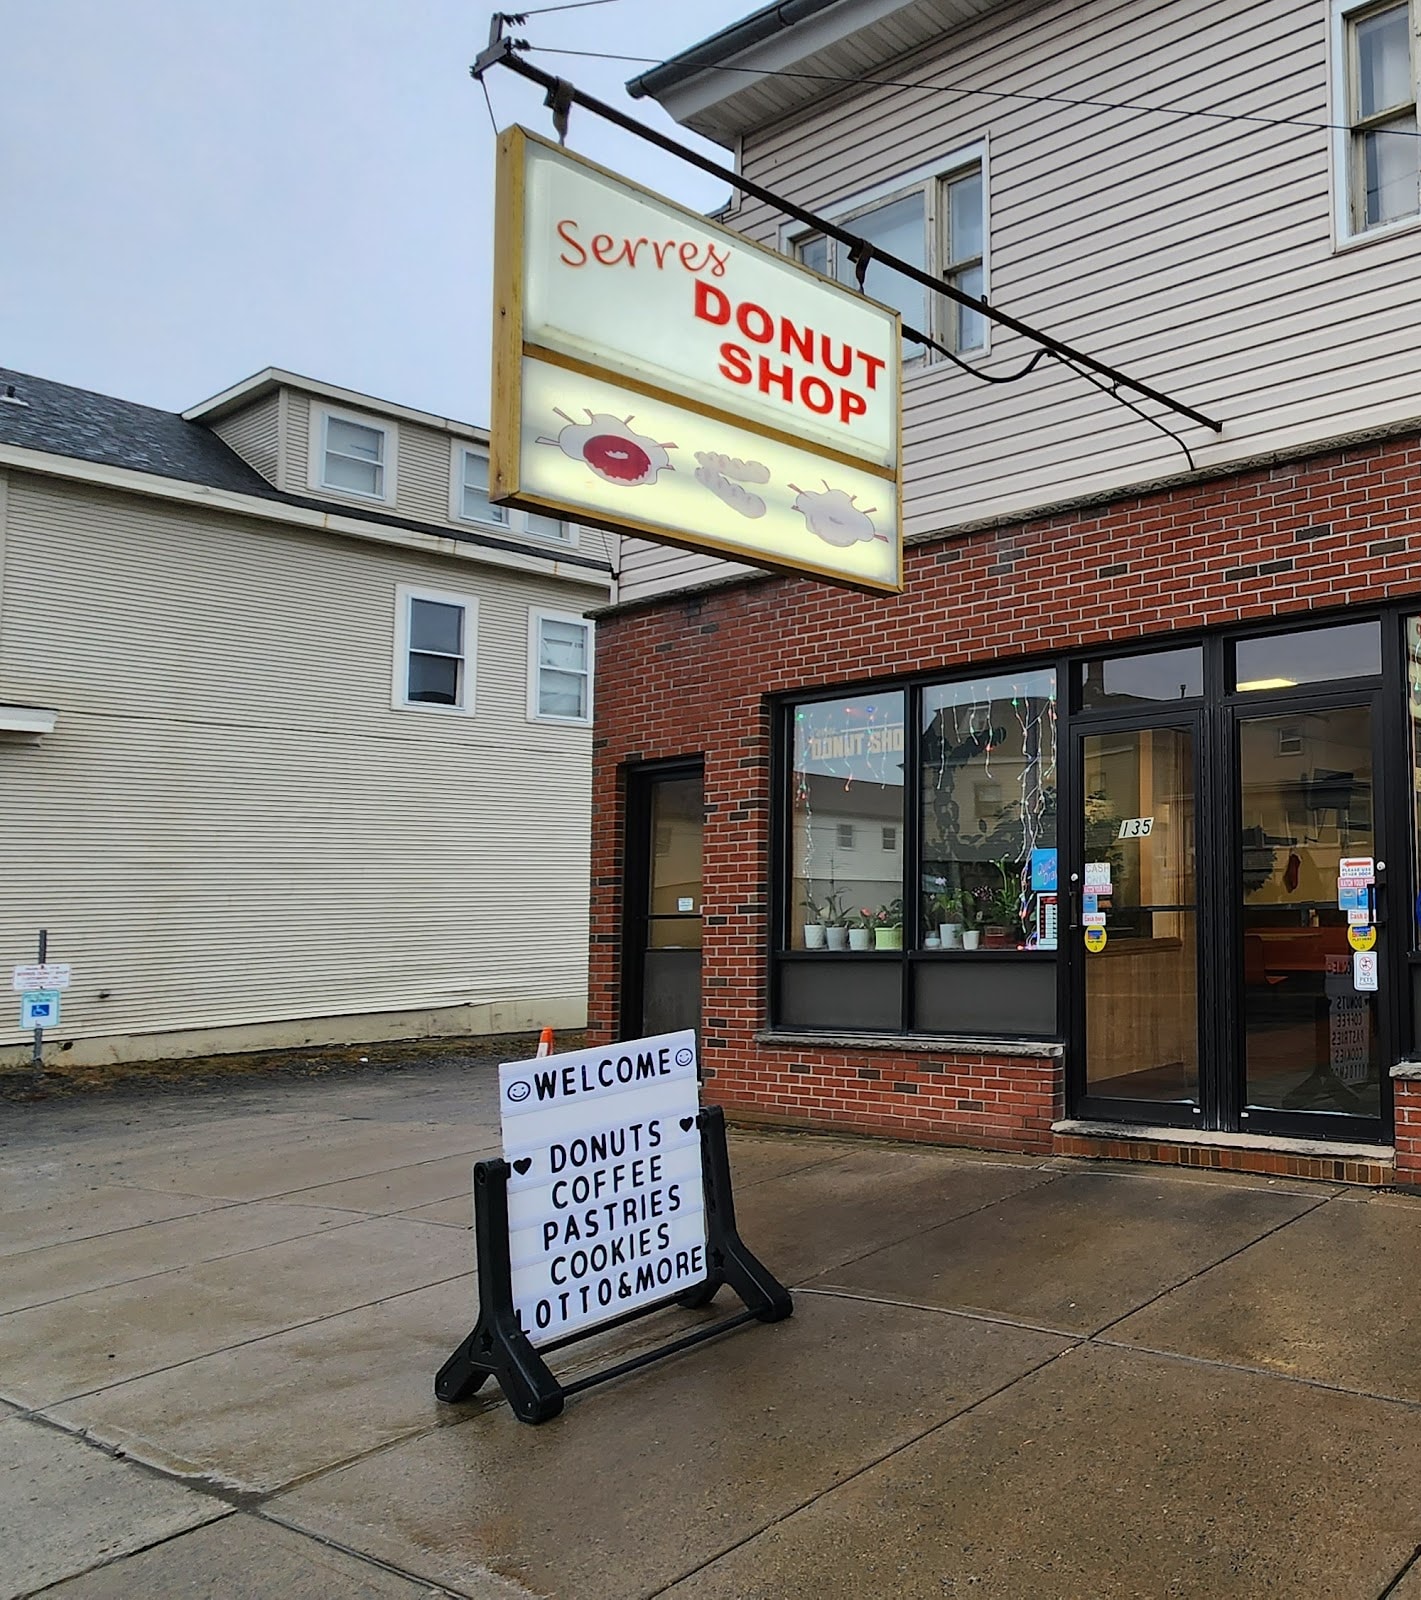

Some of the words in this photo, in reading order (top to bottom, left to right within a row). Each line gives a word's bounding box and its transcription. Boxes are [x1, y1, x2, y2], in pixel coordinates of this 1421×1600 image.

[556, 219, 731, 277] Serres
[694, 278, 886, 391] DONUT
[717, 342, 868, 425] SHOP
[870, 728, 905, 755] SHO
[1122, 819, 1152, 837] 135
[533, 1048, 671, 1101] WELCOME
[550, 1120, 662, 1174] DONUTS
[551, 1154, 663, 1209] COFFEE
[543, 1184, 681, 1251] PASTRIES
[550, 1222, 671, 1285] COOKIES
